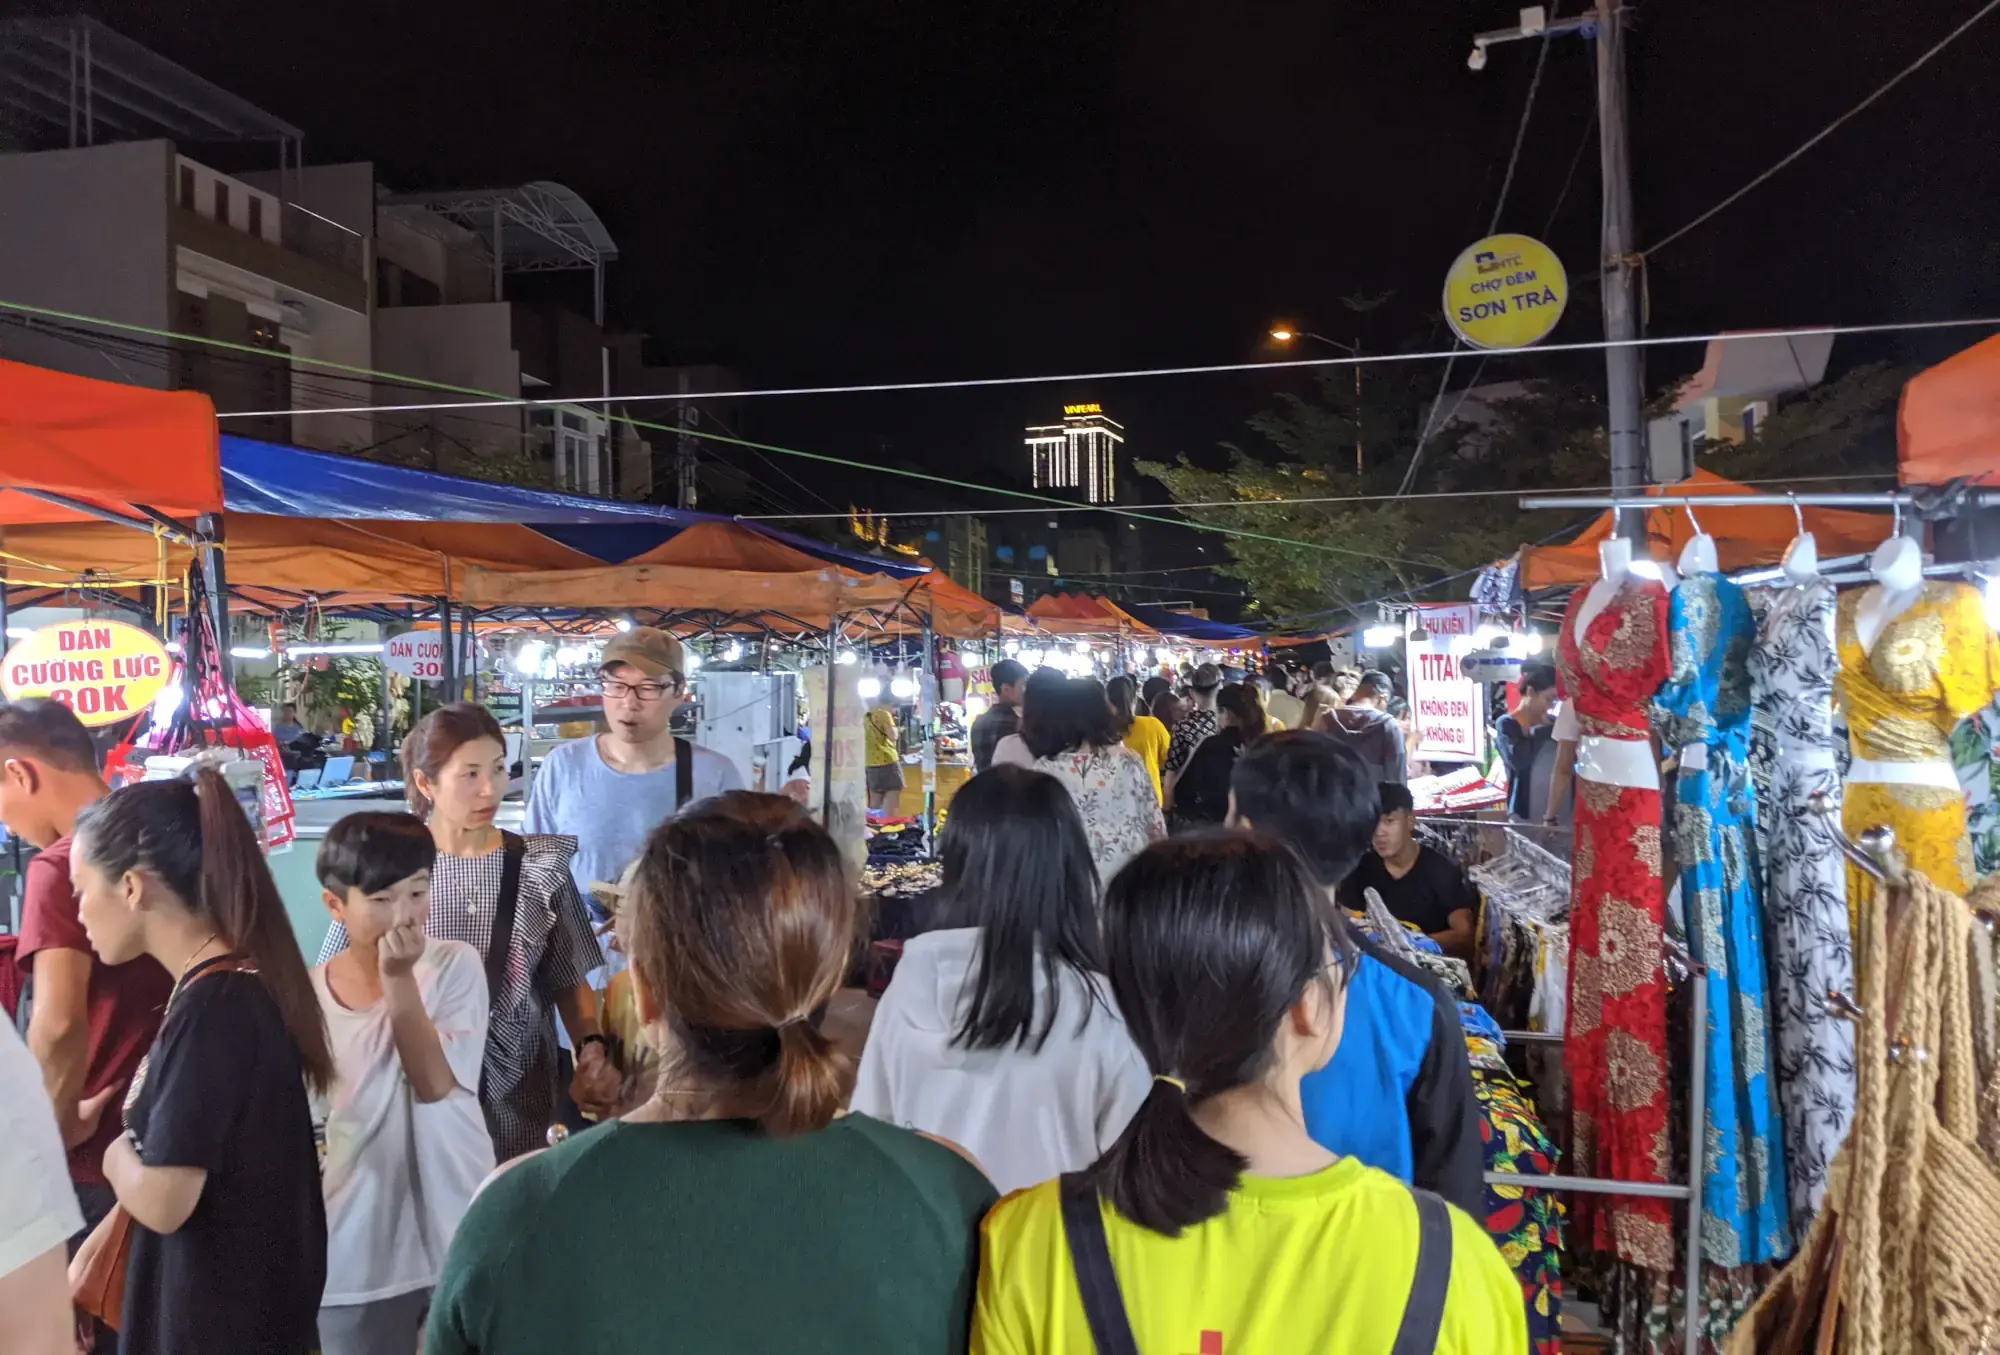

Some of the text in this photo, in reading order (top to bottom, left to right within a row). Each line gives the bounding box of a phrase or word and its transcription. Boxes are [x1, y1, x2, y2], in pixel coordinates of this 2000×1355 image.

[1459, 299, 1507, 323] SƠN
[11, 654, 161, 686] CƯỜNG LỰC
[412, 661, 444, 677] 30
